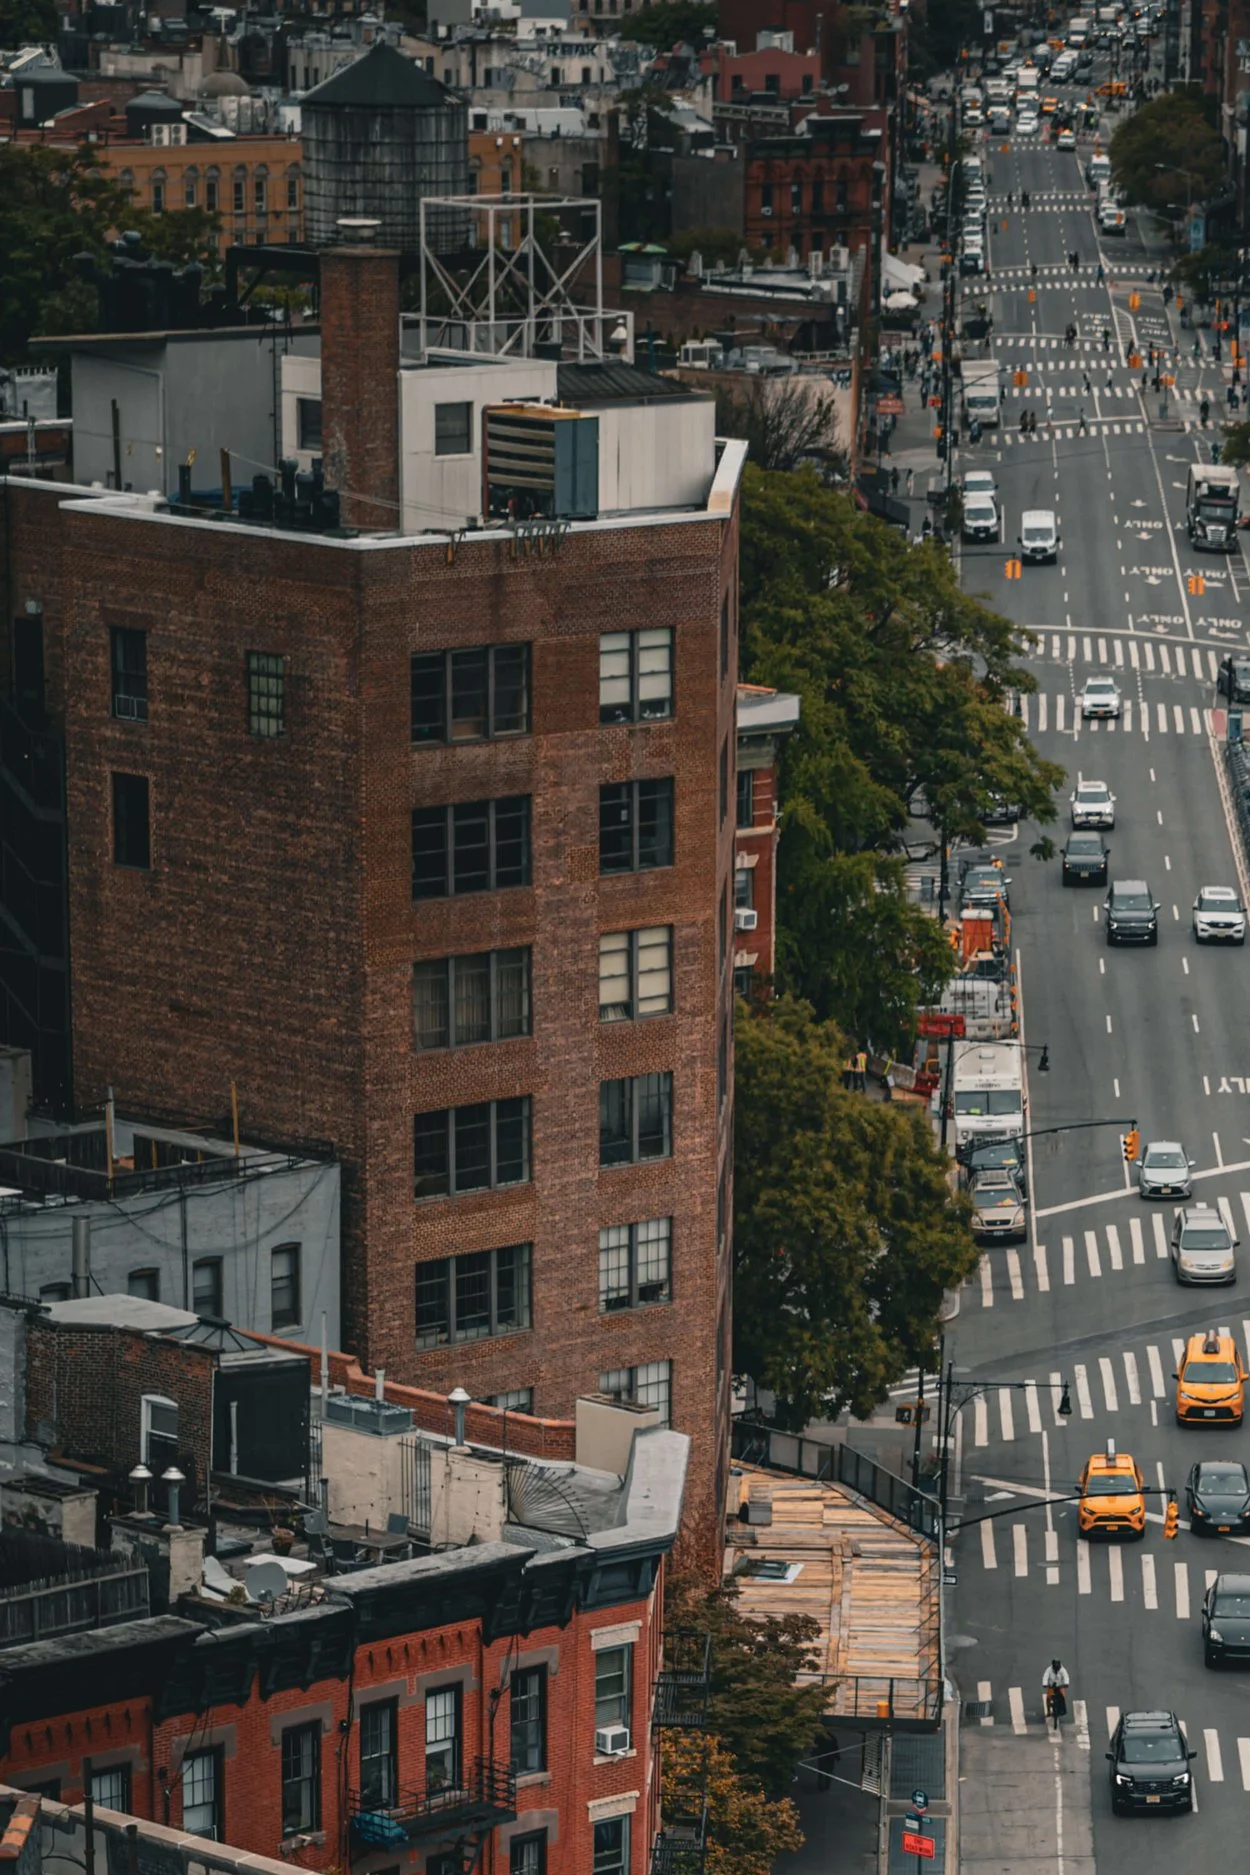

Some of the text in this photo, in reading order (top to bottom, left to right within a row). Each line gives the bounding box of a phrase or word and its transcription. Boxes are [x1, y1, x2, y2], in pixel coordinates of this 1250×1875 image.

[1124, 520, 1163, 529] ONLY
[1129, 566, 1174, 576] ONLY
[1136, 614, 1184, 624] ONLY
[1196, 617, 1242, 629] ONLY
